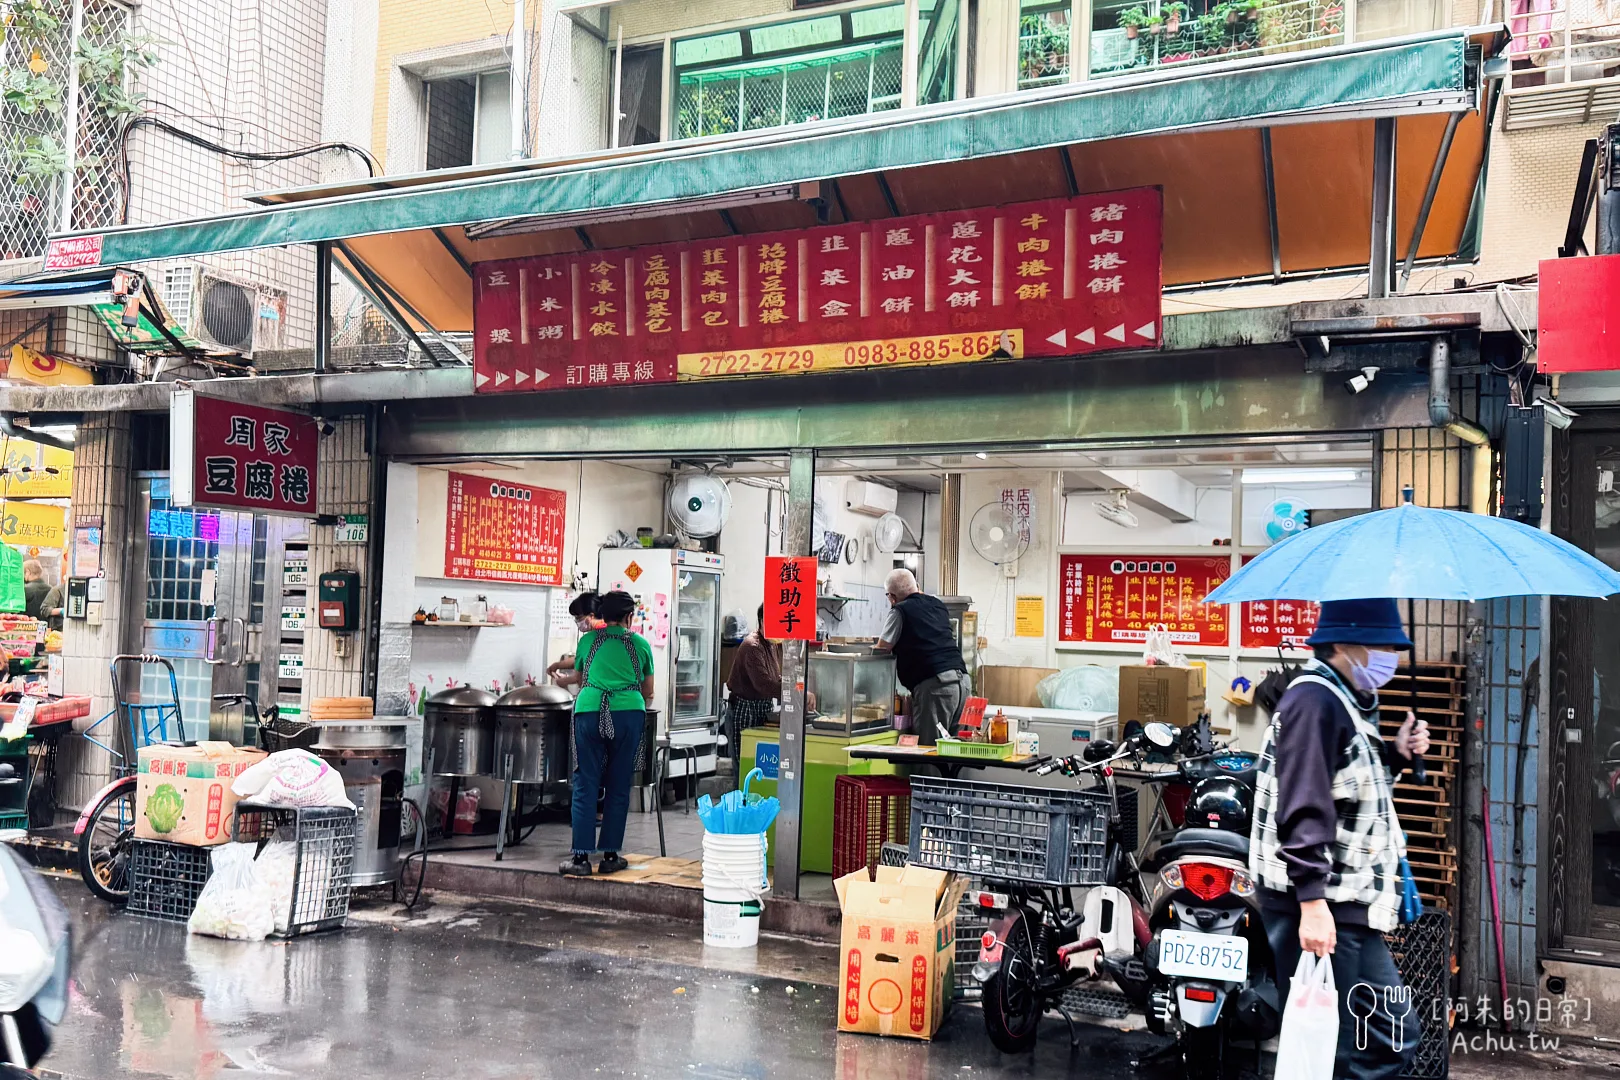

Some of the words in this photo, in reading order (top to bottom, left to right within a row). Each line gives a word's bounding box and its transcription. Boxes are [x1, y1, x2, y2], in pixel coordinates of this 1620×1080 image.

[1014, 213, 1054, 300] 牛肉捲餅
[1086, 203, 1127, 294] 豬肉捲餅
[488, 271, 513, 343] 豆漿
[537, 268, 564, 340] 小米粥
[589, 260, 619, 337] 冷凍水餃
[643, 254, 672, 333] 豆腐肉菜包
[758, 242, 790, 324] 招牌豆腐捲
[700, 349, 815, 376] 2722-2729
[225, 416, 293, 455] 周家
[205, 456, 310, 504] 豆腐捲
[19, 523, 58, 539] 蔬果行
[346, 529, 364, 540] 106
[288, 574, 302, 583] 106
[779, 561, 803, 633] 徵助手
[1099, 620, 1113, 628] 40
[1127, 621, 1142, 629] 40
[1180, 622, 1195, 630] 25
[1209, 623, 1224, 632] 25
[1275, 626, 1295, 634] 100
[216, 762, 254, 777] 高麗
